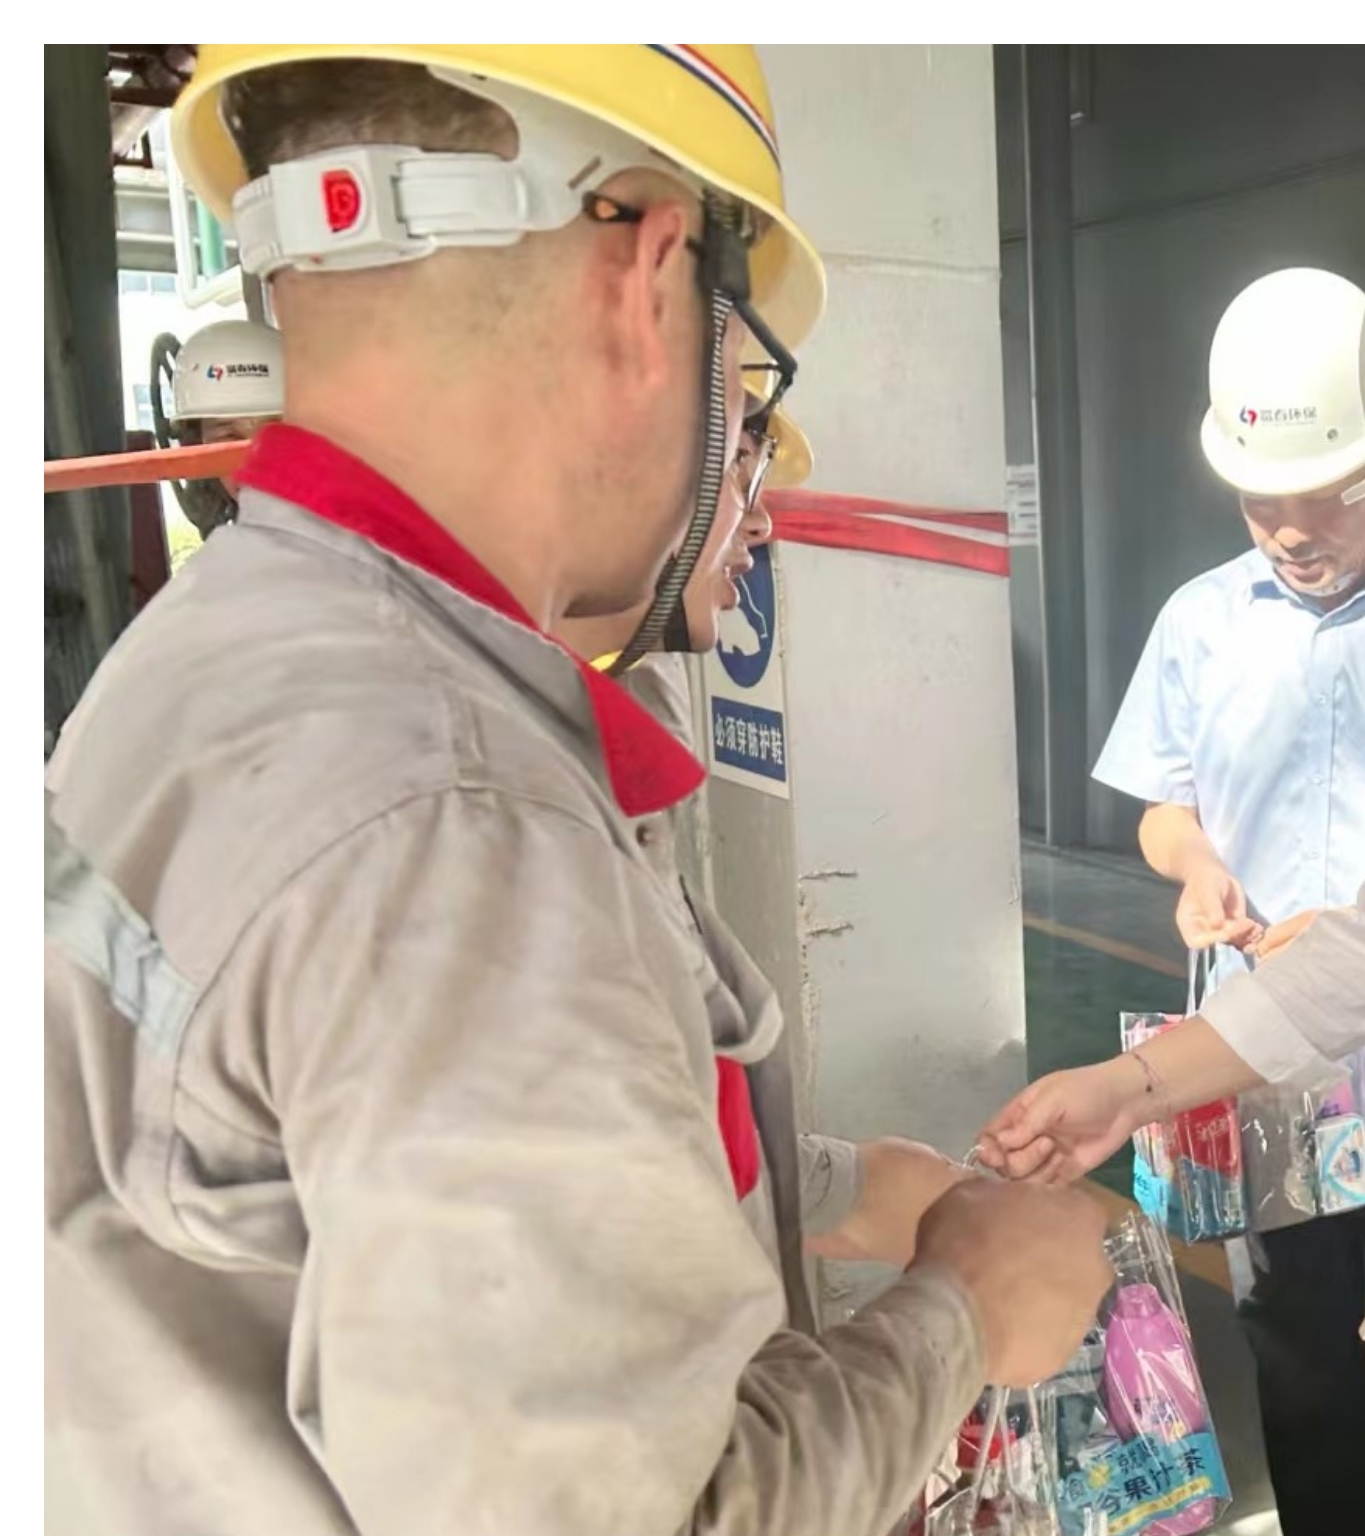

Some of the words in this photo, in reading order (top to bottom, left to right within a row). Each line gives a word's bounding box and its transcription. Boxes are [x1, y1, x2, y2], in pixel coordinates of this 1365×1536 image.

[715, 713, 783, 767] 必须穿防护鞋
